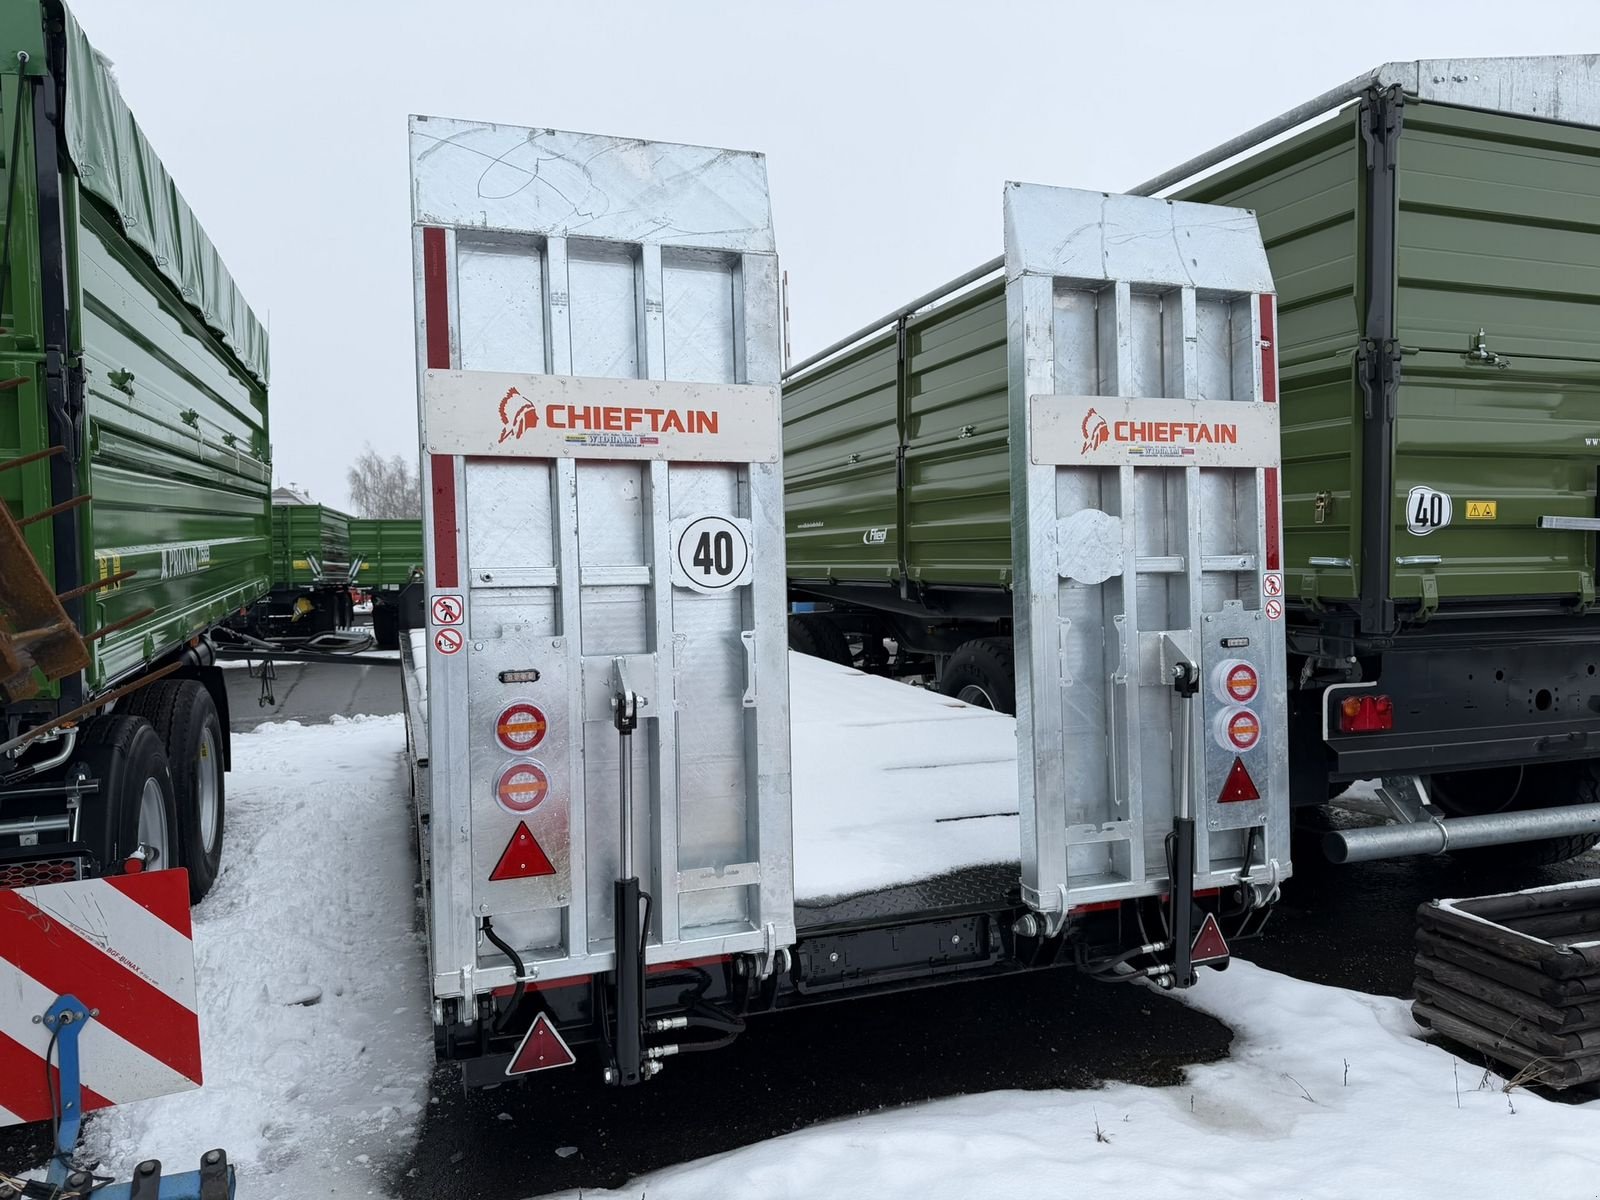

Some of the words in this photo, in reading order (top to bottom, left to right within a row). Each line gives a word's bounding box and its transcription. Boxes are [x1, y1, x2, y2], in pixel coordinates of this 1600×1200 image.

[546, 404, 718, 434] CHIEFTAIN
[1114, 421, 1237, 444] CHIEFTAIN
[589, 435, 638, 444] WIDHALM
[1415, 493, 1443, 527] 40
[169, 546, 198, 578] PRONAR
[693, 531, 733, 576] 40
[106, 947, 141, 972] BGF-BUNAX
